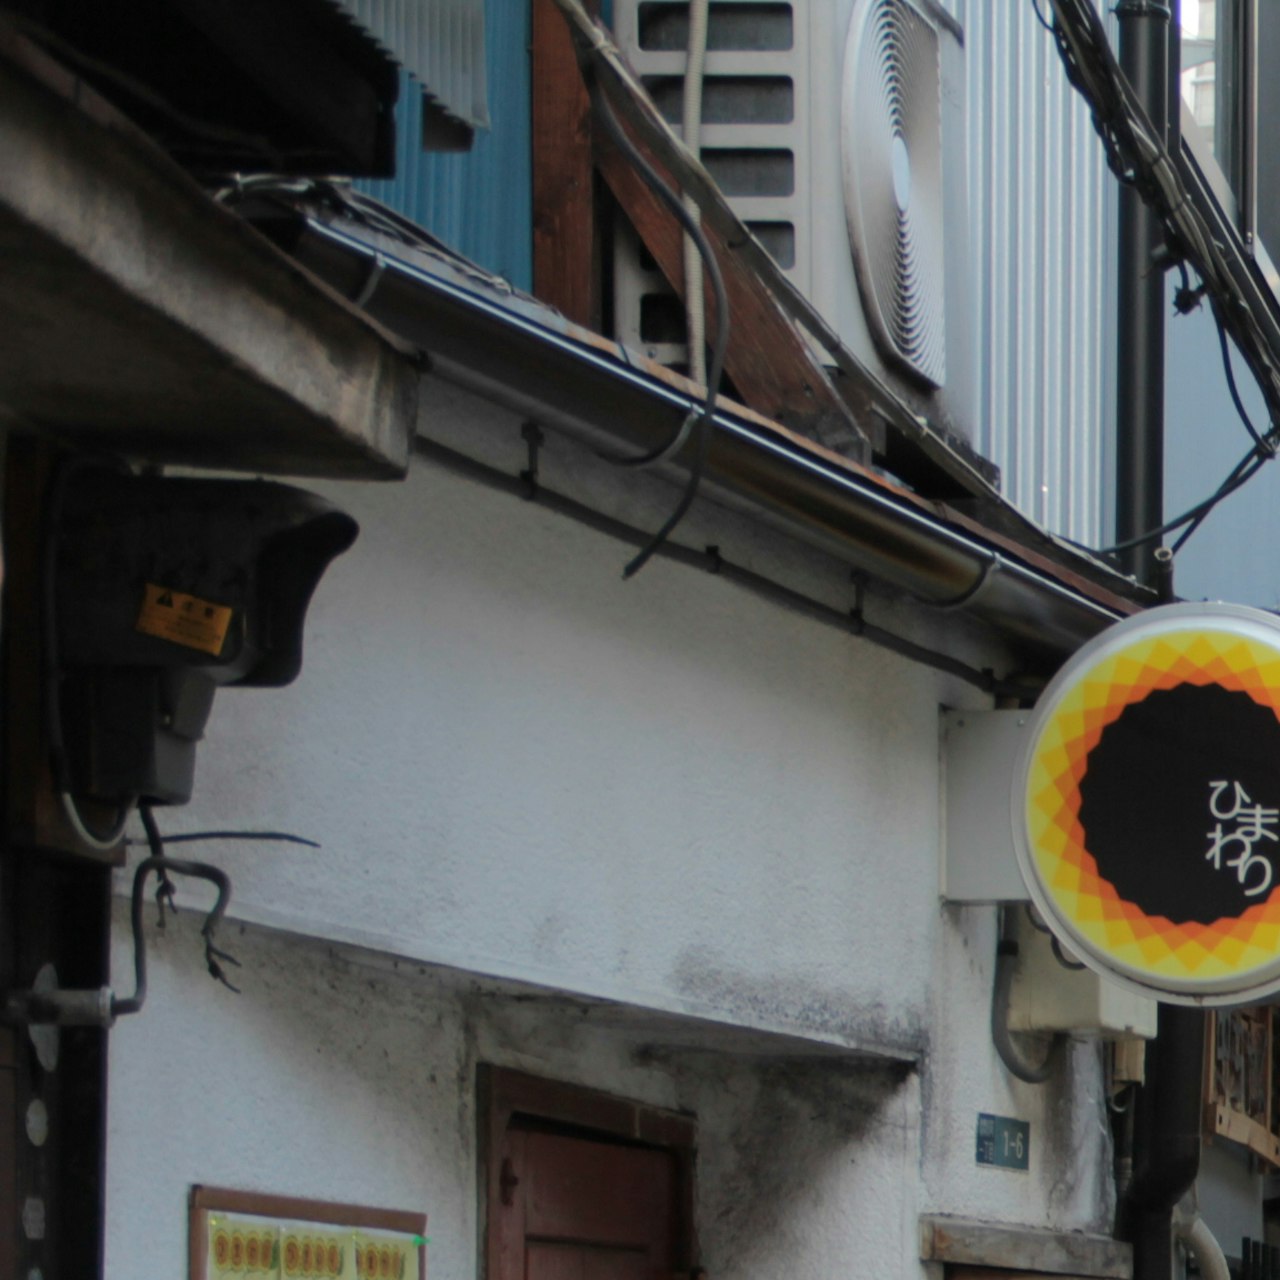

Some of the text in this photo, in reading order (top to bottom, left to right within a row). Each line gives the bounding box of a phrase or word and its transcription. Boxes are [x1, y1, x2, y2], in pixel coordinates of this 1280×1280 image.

[1205, 780, 1280, 896] ひまわり
[1003, 1130, 1024, 1159] 1-6
